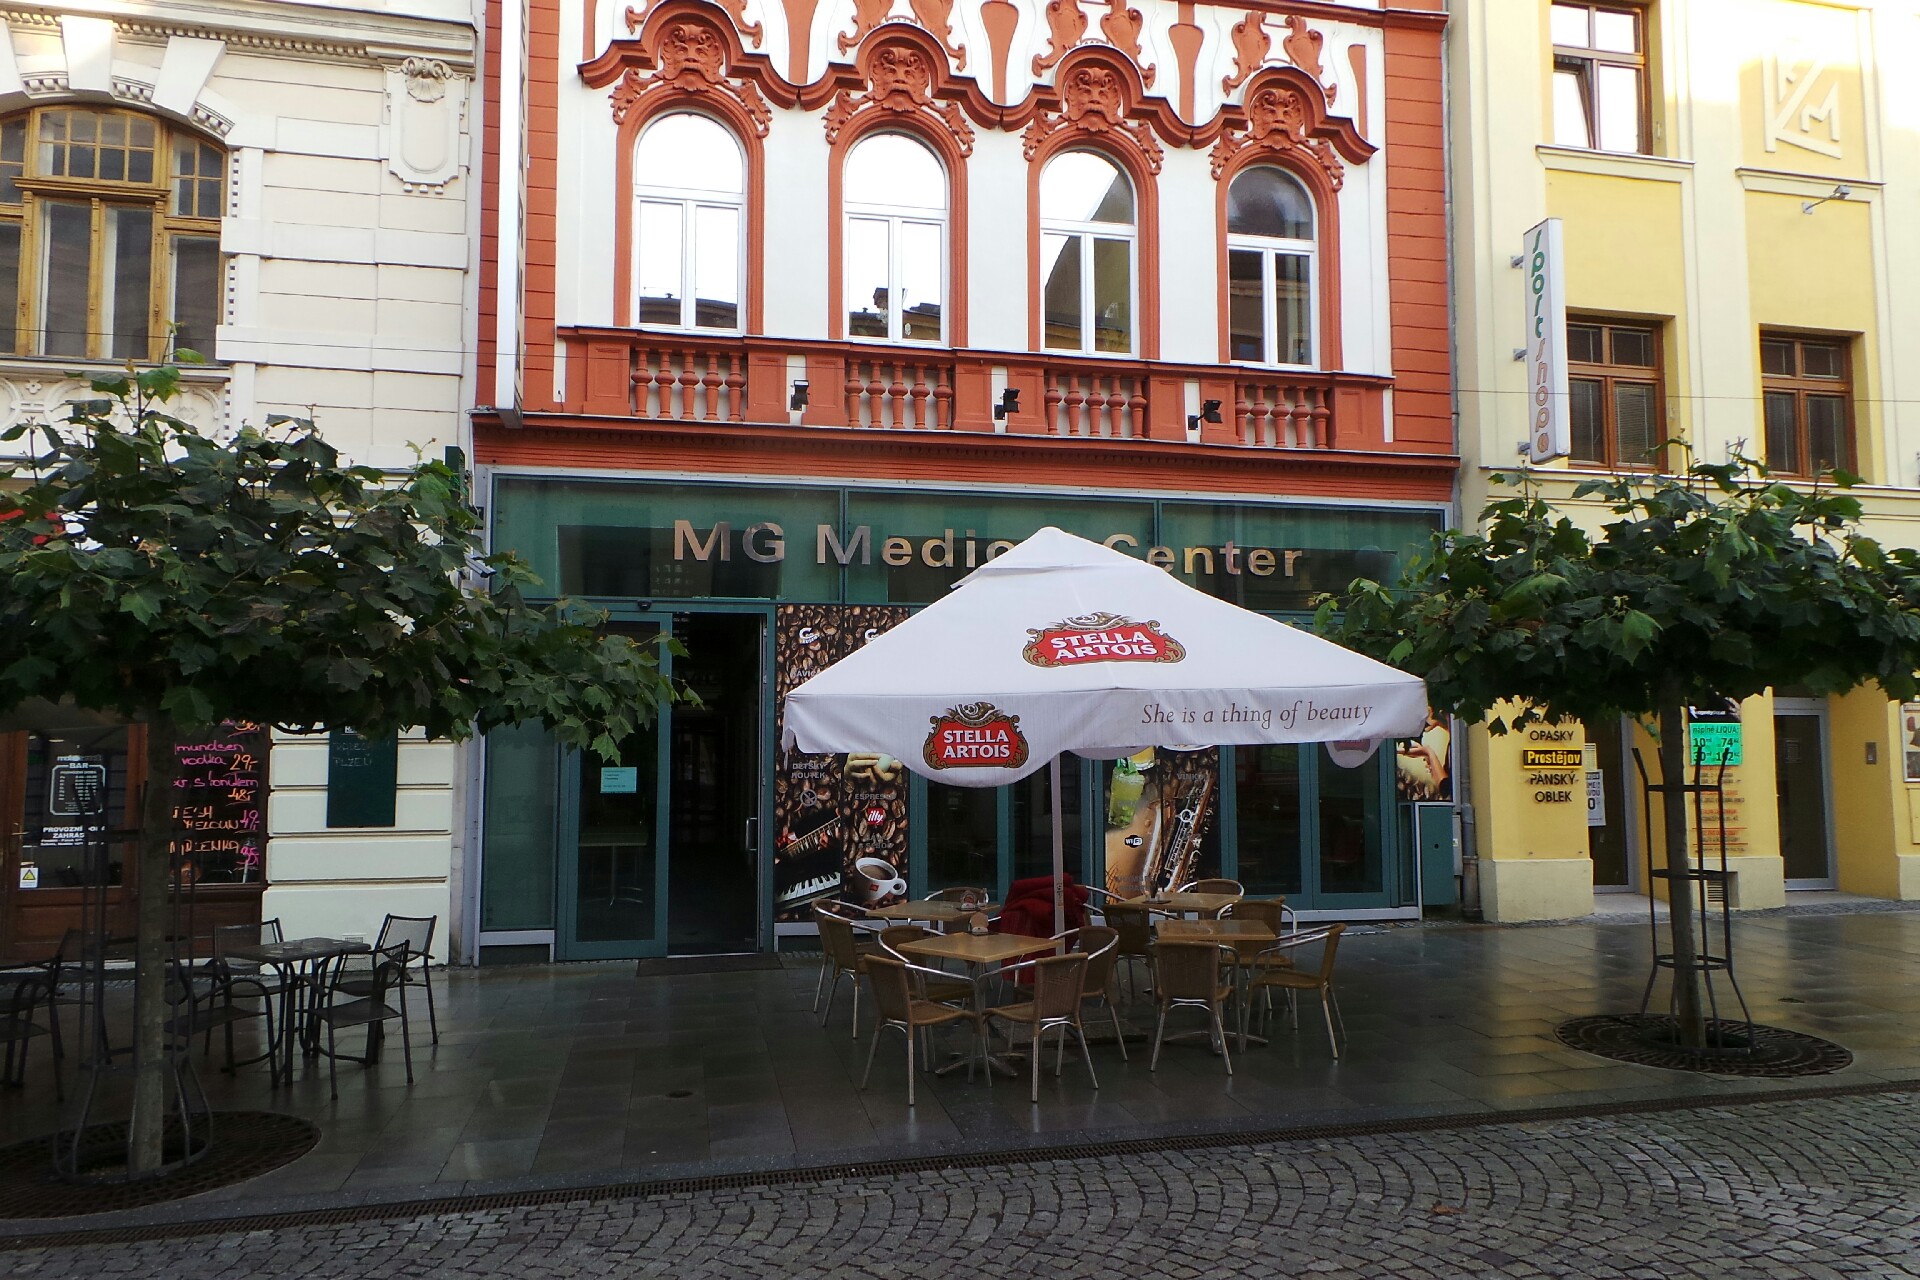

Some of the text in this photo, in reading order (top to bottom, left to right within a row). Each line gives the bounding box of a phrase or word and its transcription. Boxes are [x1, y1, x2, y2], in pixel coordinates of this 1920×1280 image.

[1530, 229, 1546, 339] sport
[674, 520, 785, 563] MG
[817, 524, 1072, 568] Medi
[1050, 631, 1150, 648] STELLA
[1055, 644, 1158, 660] ARTOIS
[1142, 700, 1373, 730] She is a thing of beauty
[943, 729, 1009, 743] STELLA
[1530, 730, 1574, 741] OPASKY
[943, 744, 1011, 758] ARTOIS
[1527, 750, 1581, 766] Prostějov
[1529, 770, 1576, 785] PÁNSKÝ
[1535, 791, 1573, 803] OBLEK
[867, 810, 884, 824] illy
